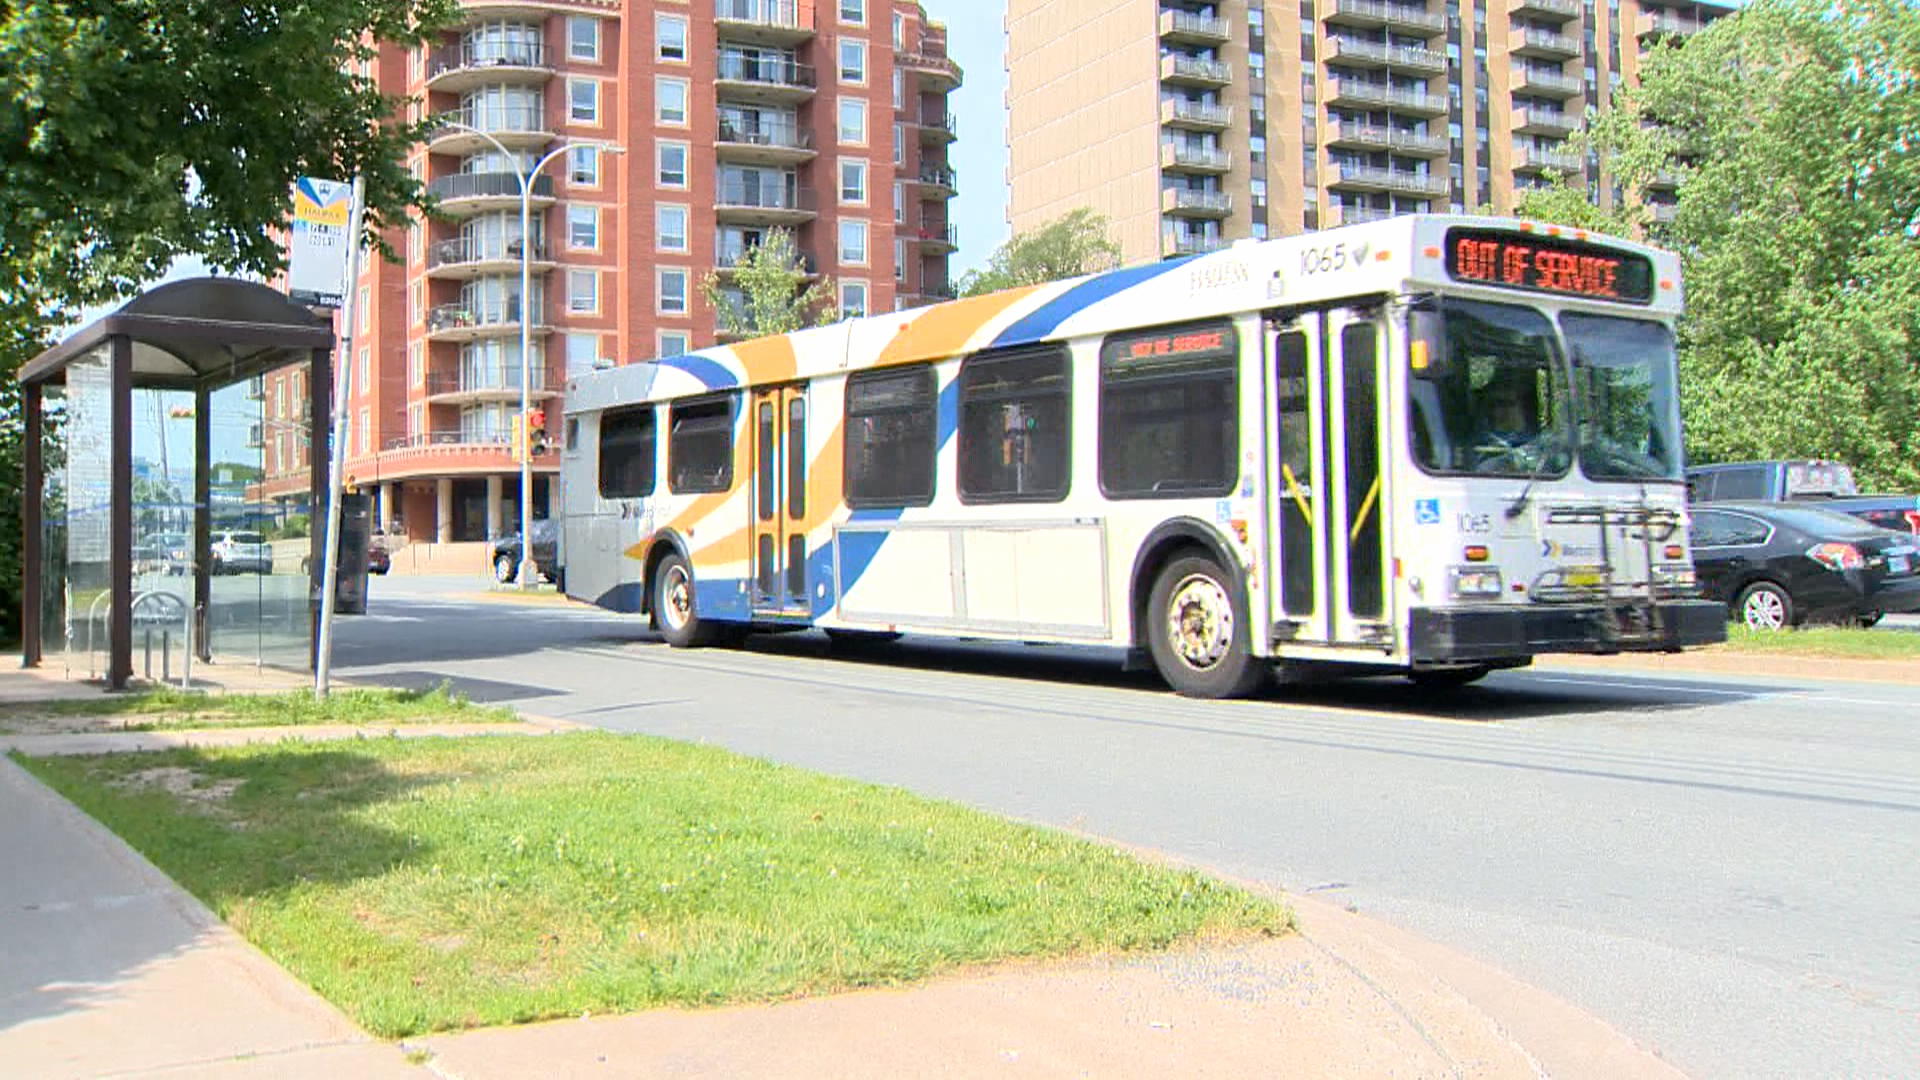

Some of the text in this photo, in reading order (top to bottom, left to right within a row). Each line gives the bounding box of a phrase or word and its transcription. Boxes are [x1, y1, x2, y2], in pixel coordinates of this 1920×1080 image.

[1300, 243, 1346, 276] 1065
[1457, 238, 1620, 297] OUT OF SERVICE
[1457, 512, 1489, 533] 1065
